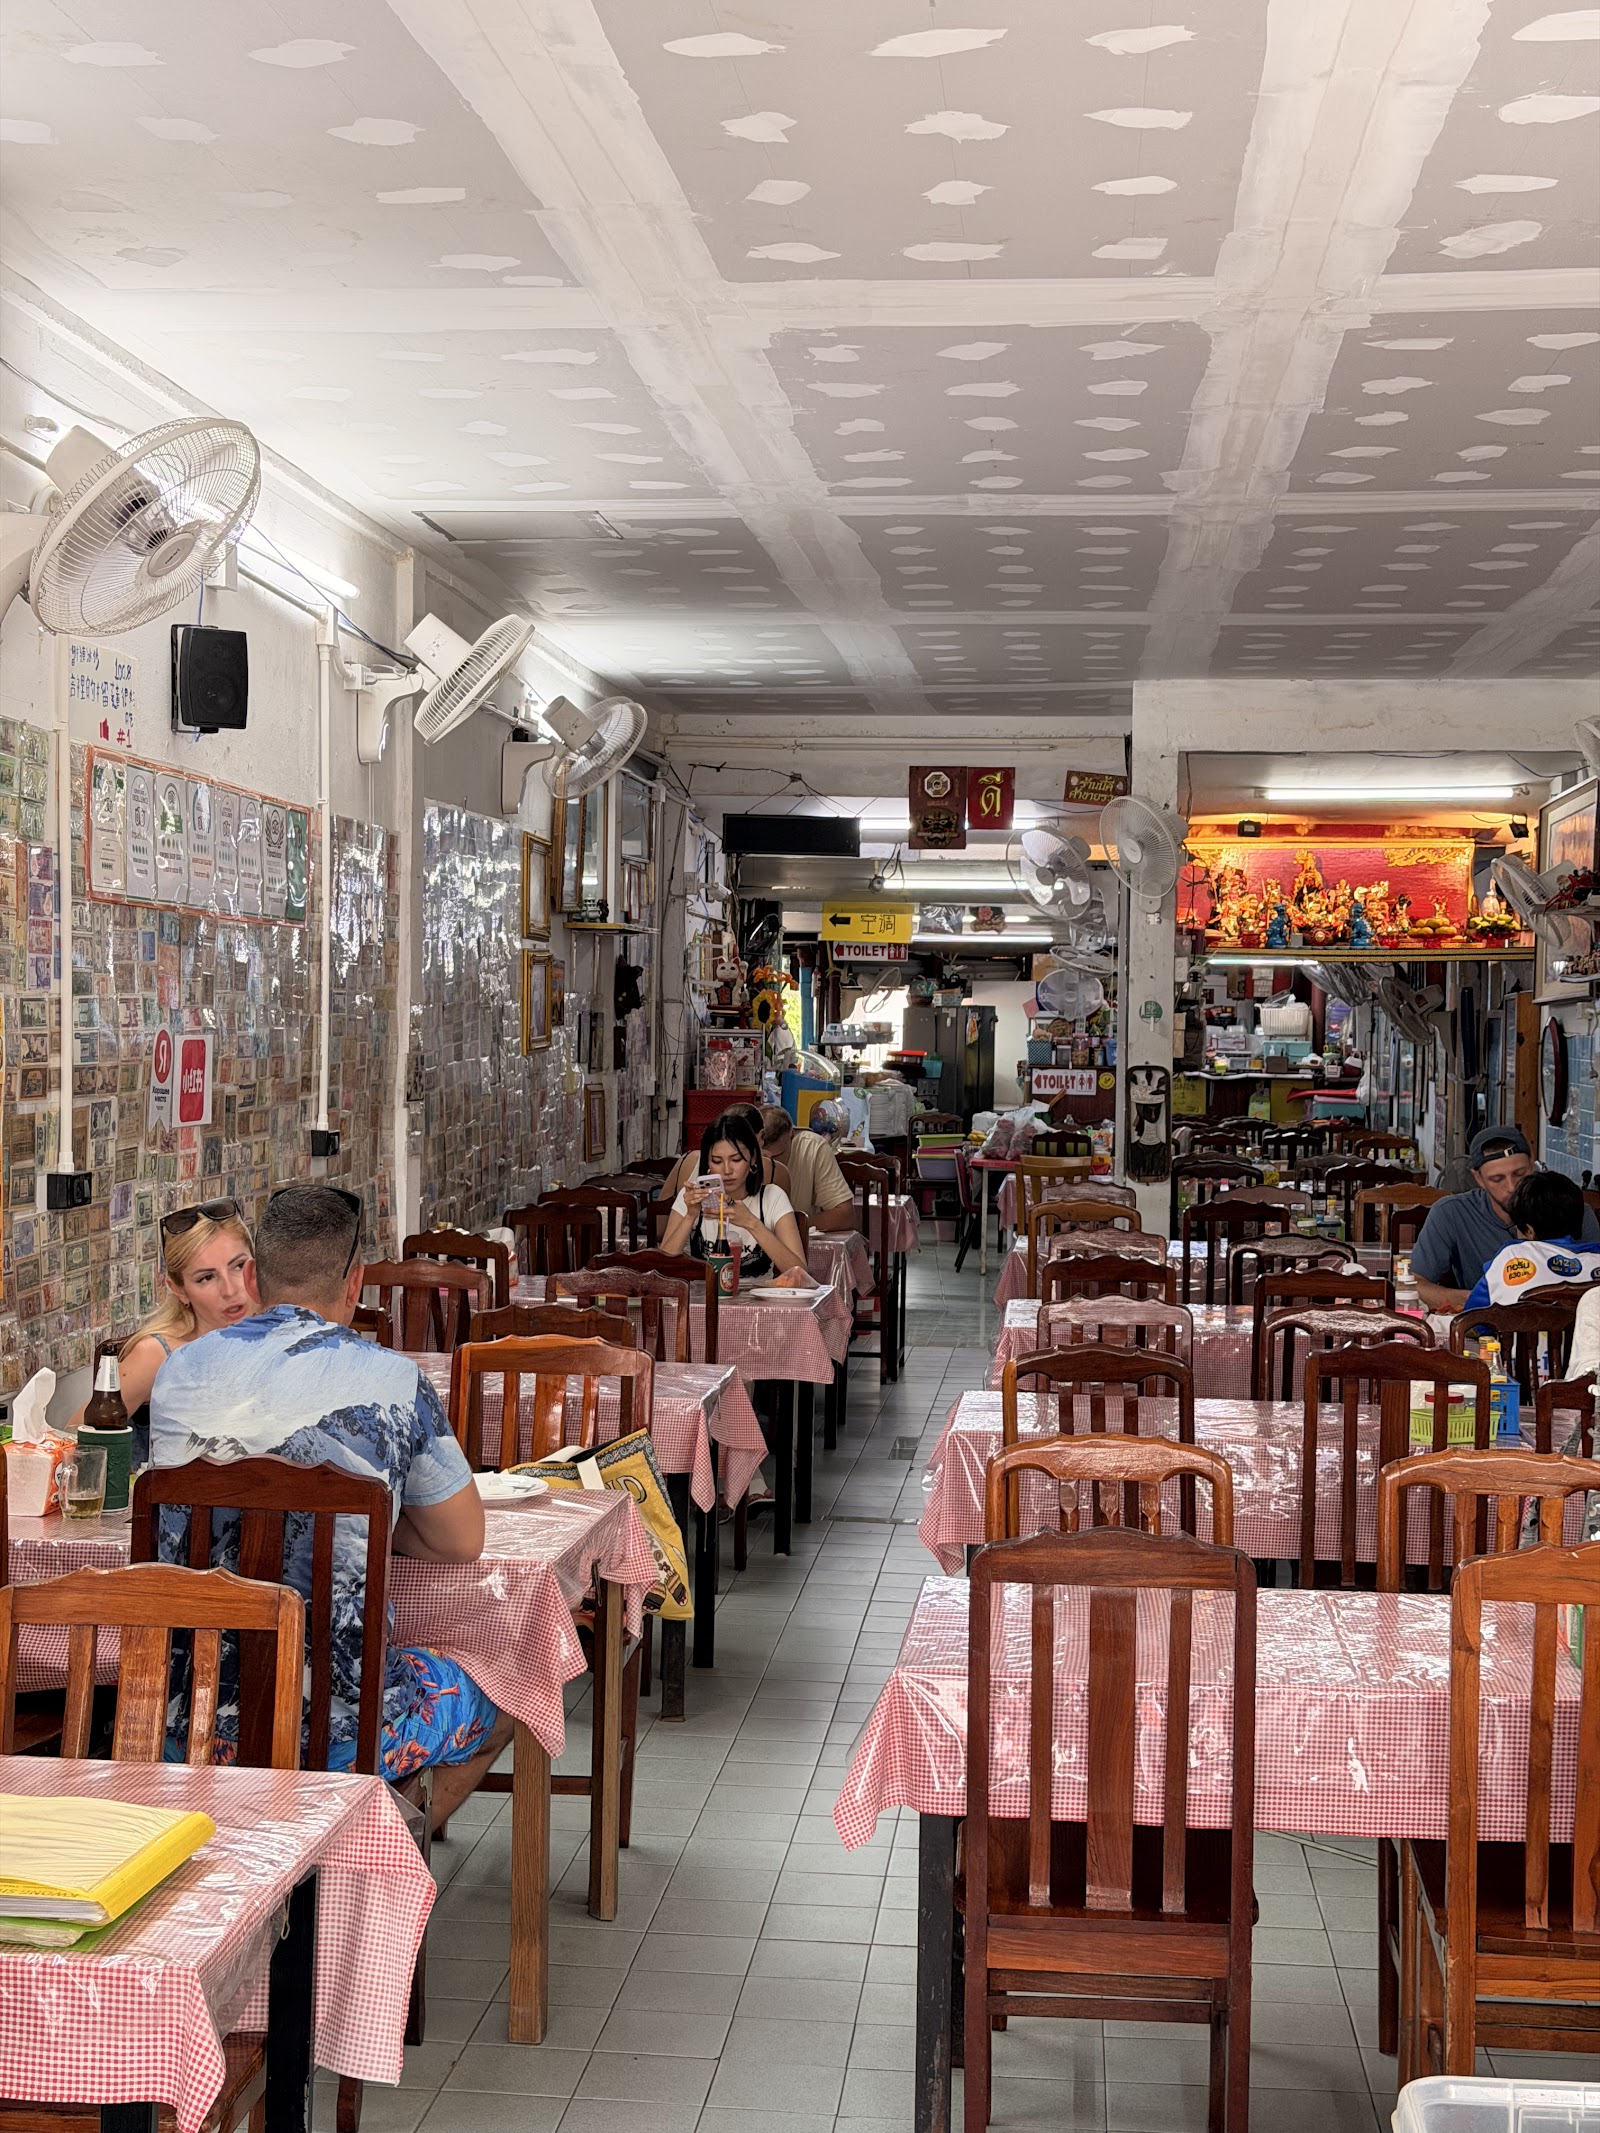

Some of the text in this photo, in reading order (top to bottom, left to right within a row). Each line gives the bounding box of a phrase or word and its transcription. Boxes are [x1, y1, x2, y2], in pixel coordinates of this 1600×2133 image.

[117, 728, 132, 748] #1
[978, 771, 1004, 817] ดี
[861, 914, 896, 935] 空调
[845, 945, 886, 956] TOILET
[158, 1040, 167, 1073] Я
[183, 1068, 203, 1094] 小红书
[1043, 1074, 1076, 1090] TOILET
